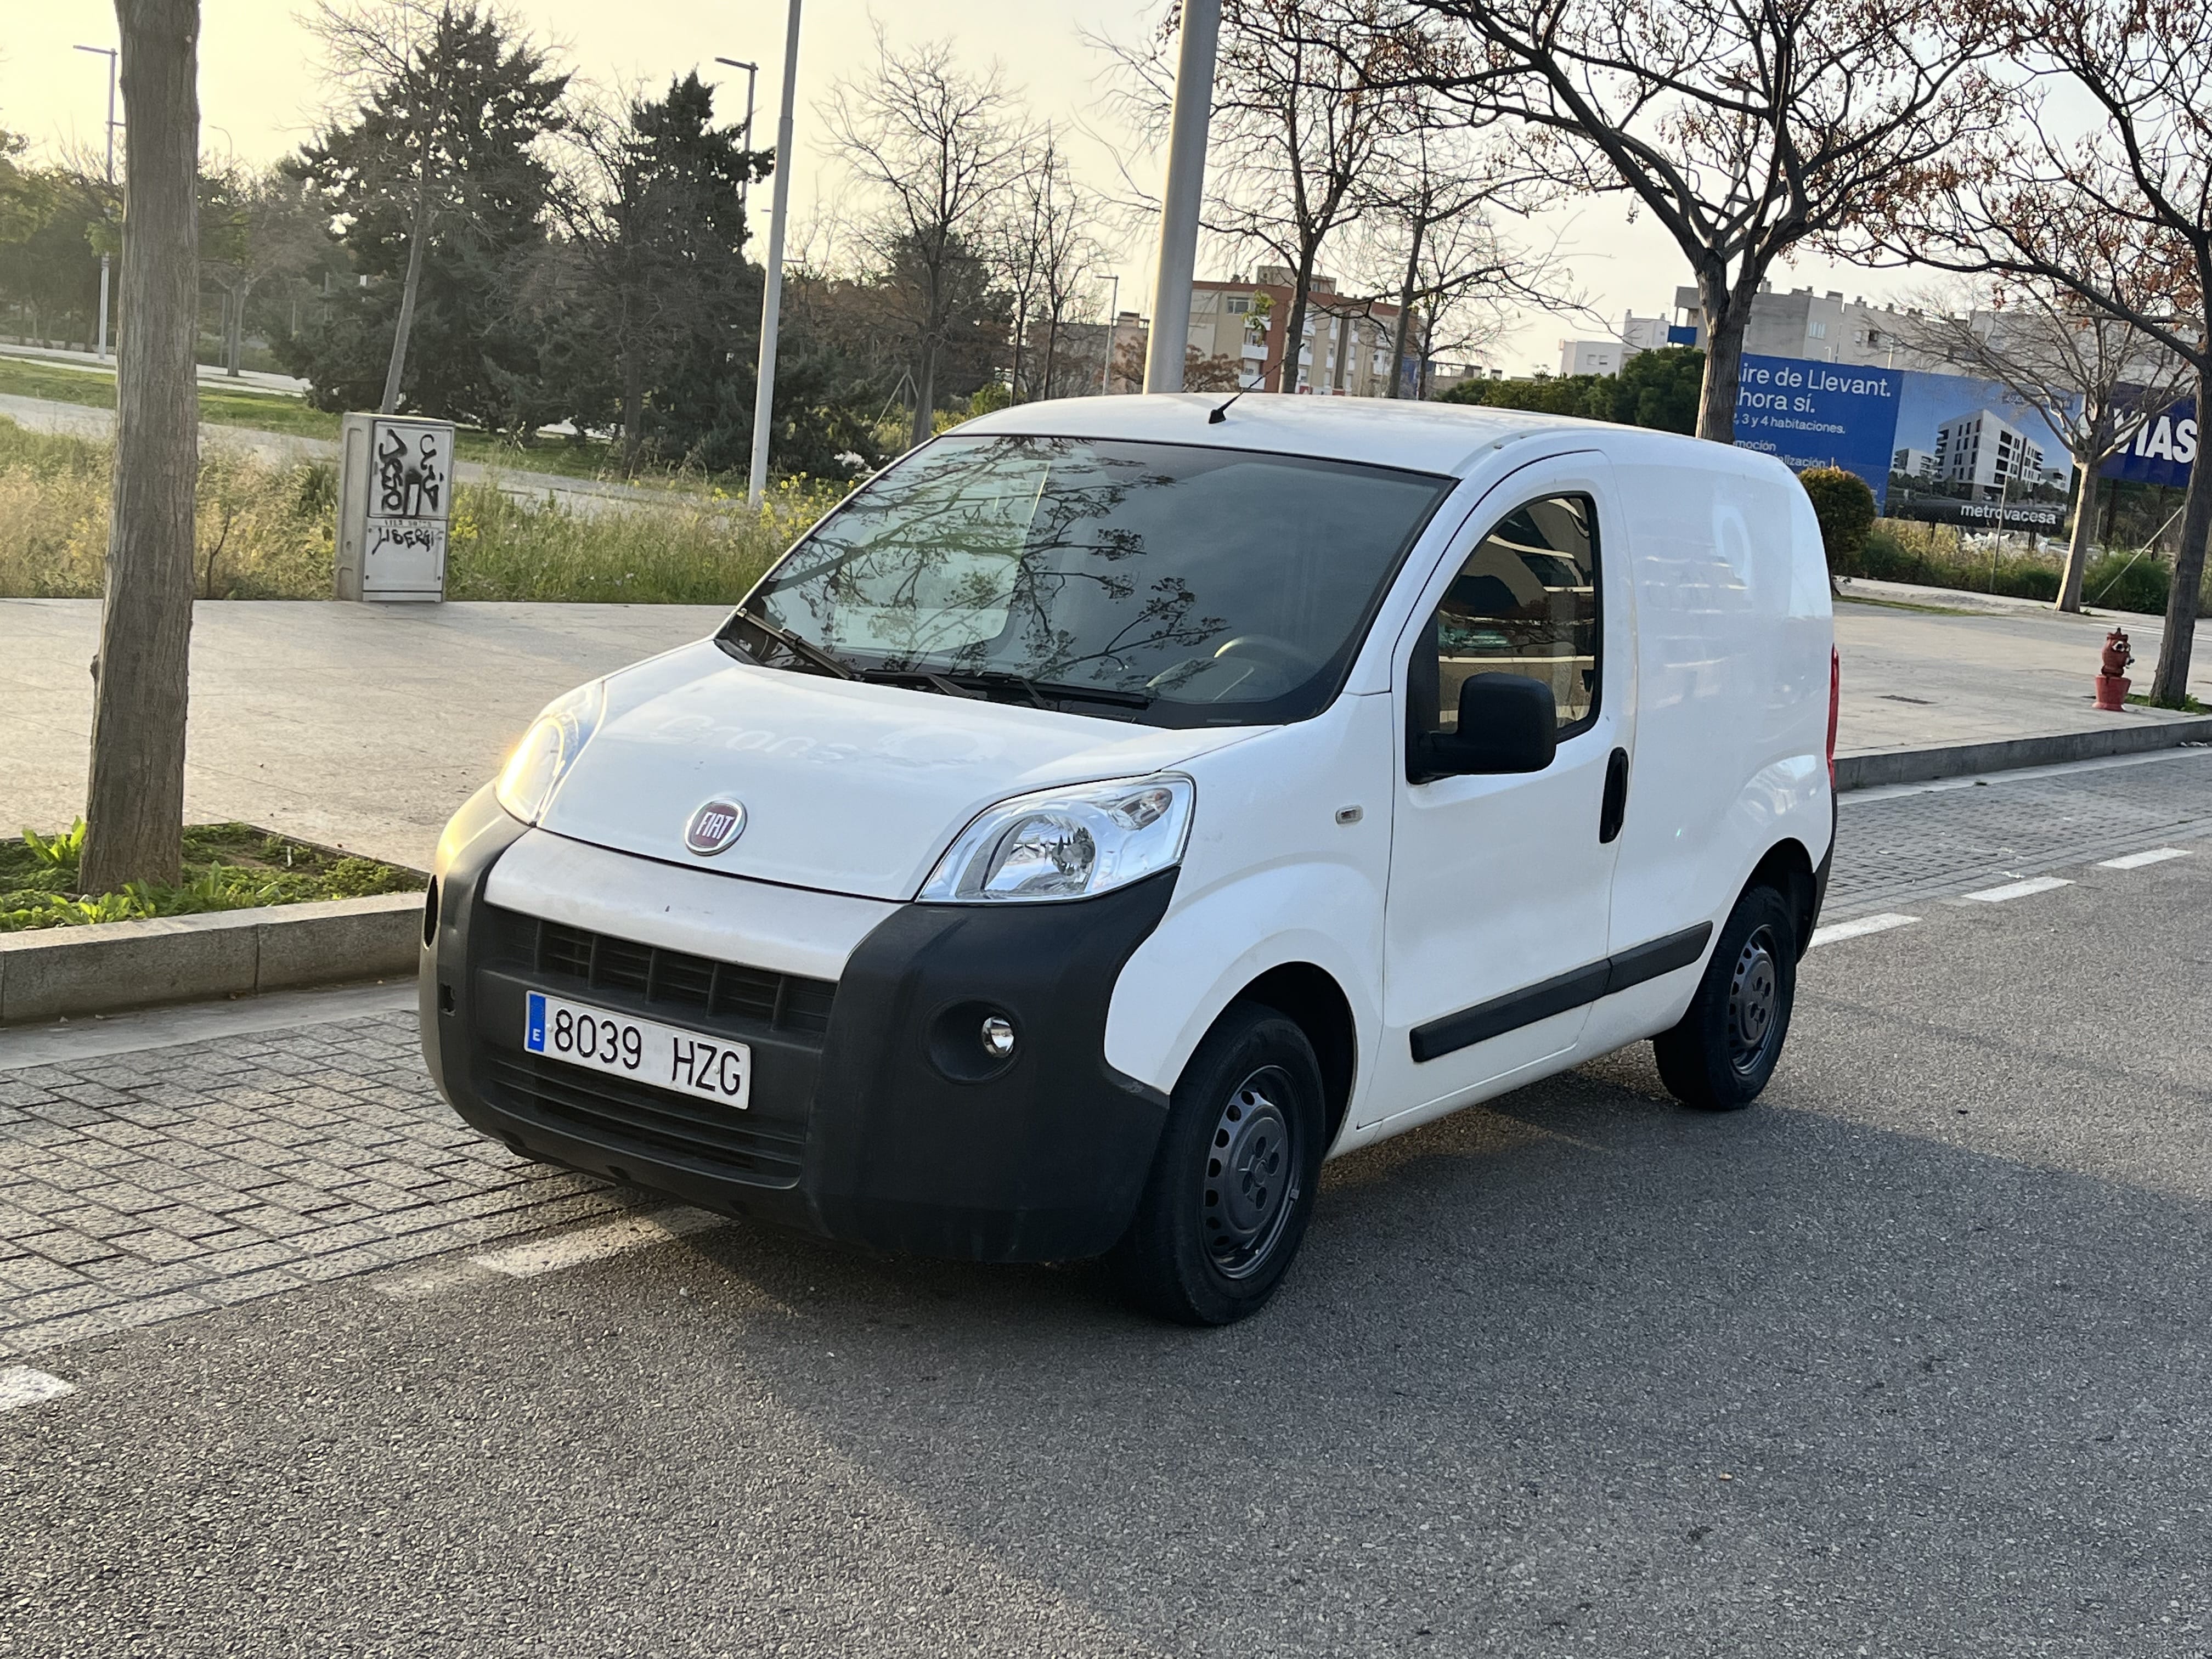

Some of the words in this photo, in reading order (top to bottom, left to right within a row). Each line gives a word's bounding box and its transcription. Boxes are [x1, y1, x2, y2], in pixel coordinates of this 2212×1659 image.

[1738, 363, 1770, 384] ire
[1775, 367, 1802, 387] de
[1808, 369, 1891, 397] Llevant.
[1736, 387, 1788, 411] hora
[1793, 393, 1815, 413] sí.
[1742, 413, 1750, 425] 3
[1751, 417, 1759, 428] y
[1760, 415, 1769, 426] 4
[1770, 416, 1846, 435] habitaciones.
[1960, 504, 2056, 525] metrovacesa
[696, 812, 735, 839] FIAT
[533, 1028, 541, 1042] E
[554, 1009, 642, 1069] 8039
[672, 1036, 741, 1095] HZG
